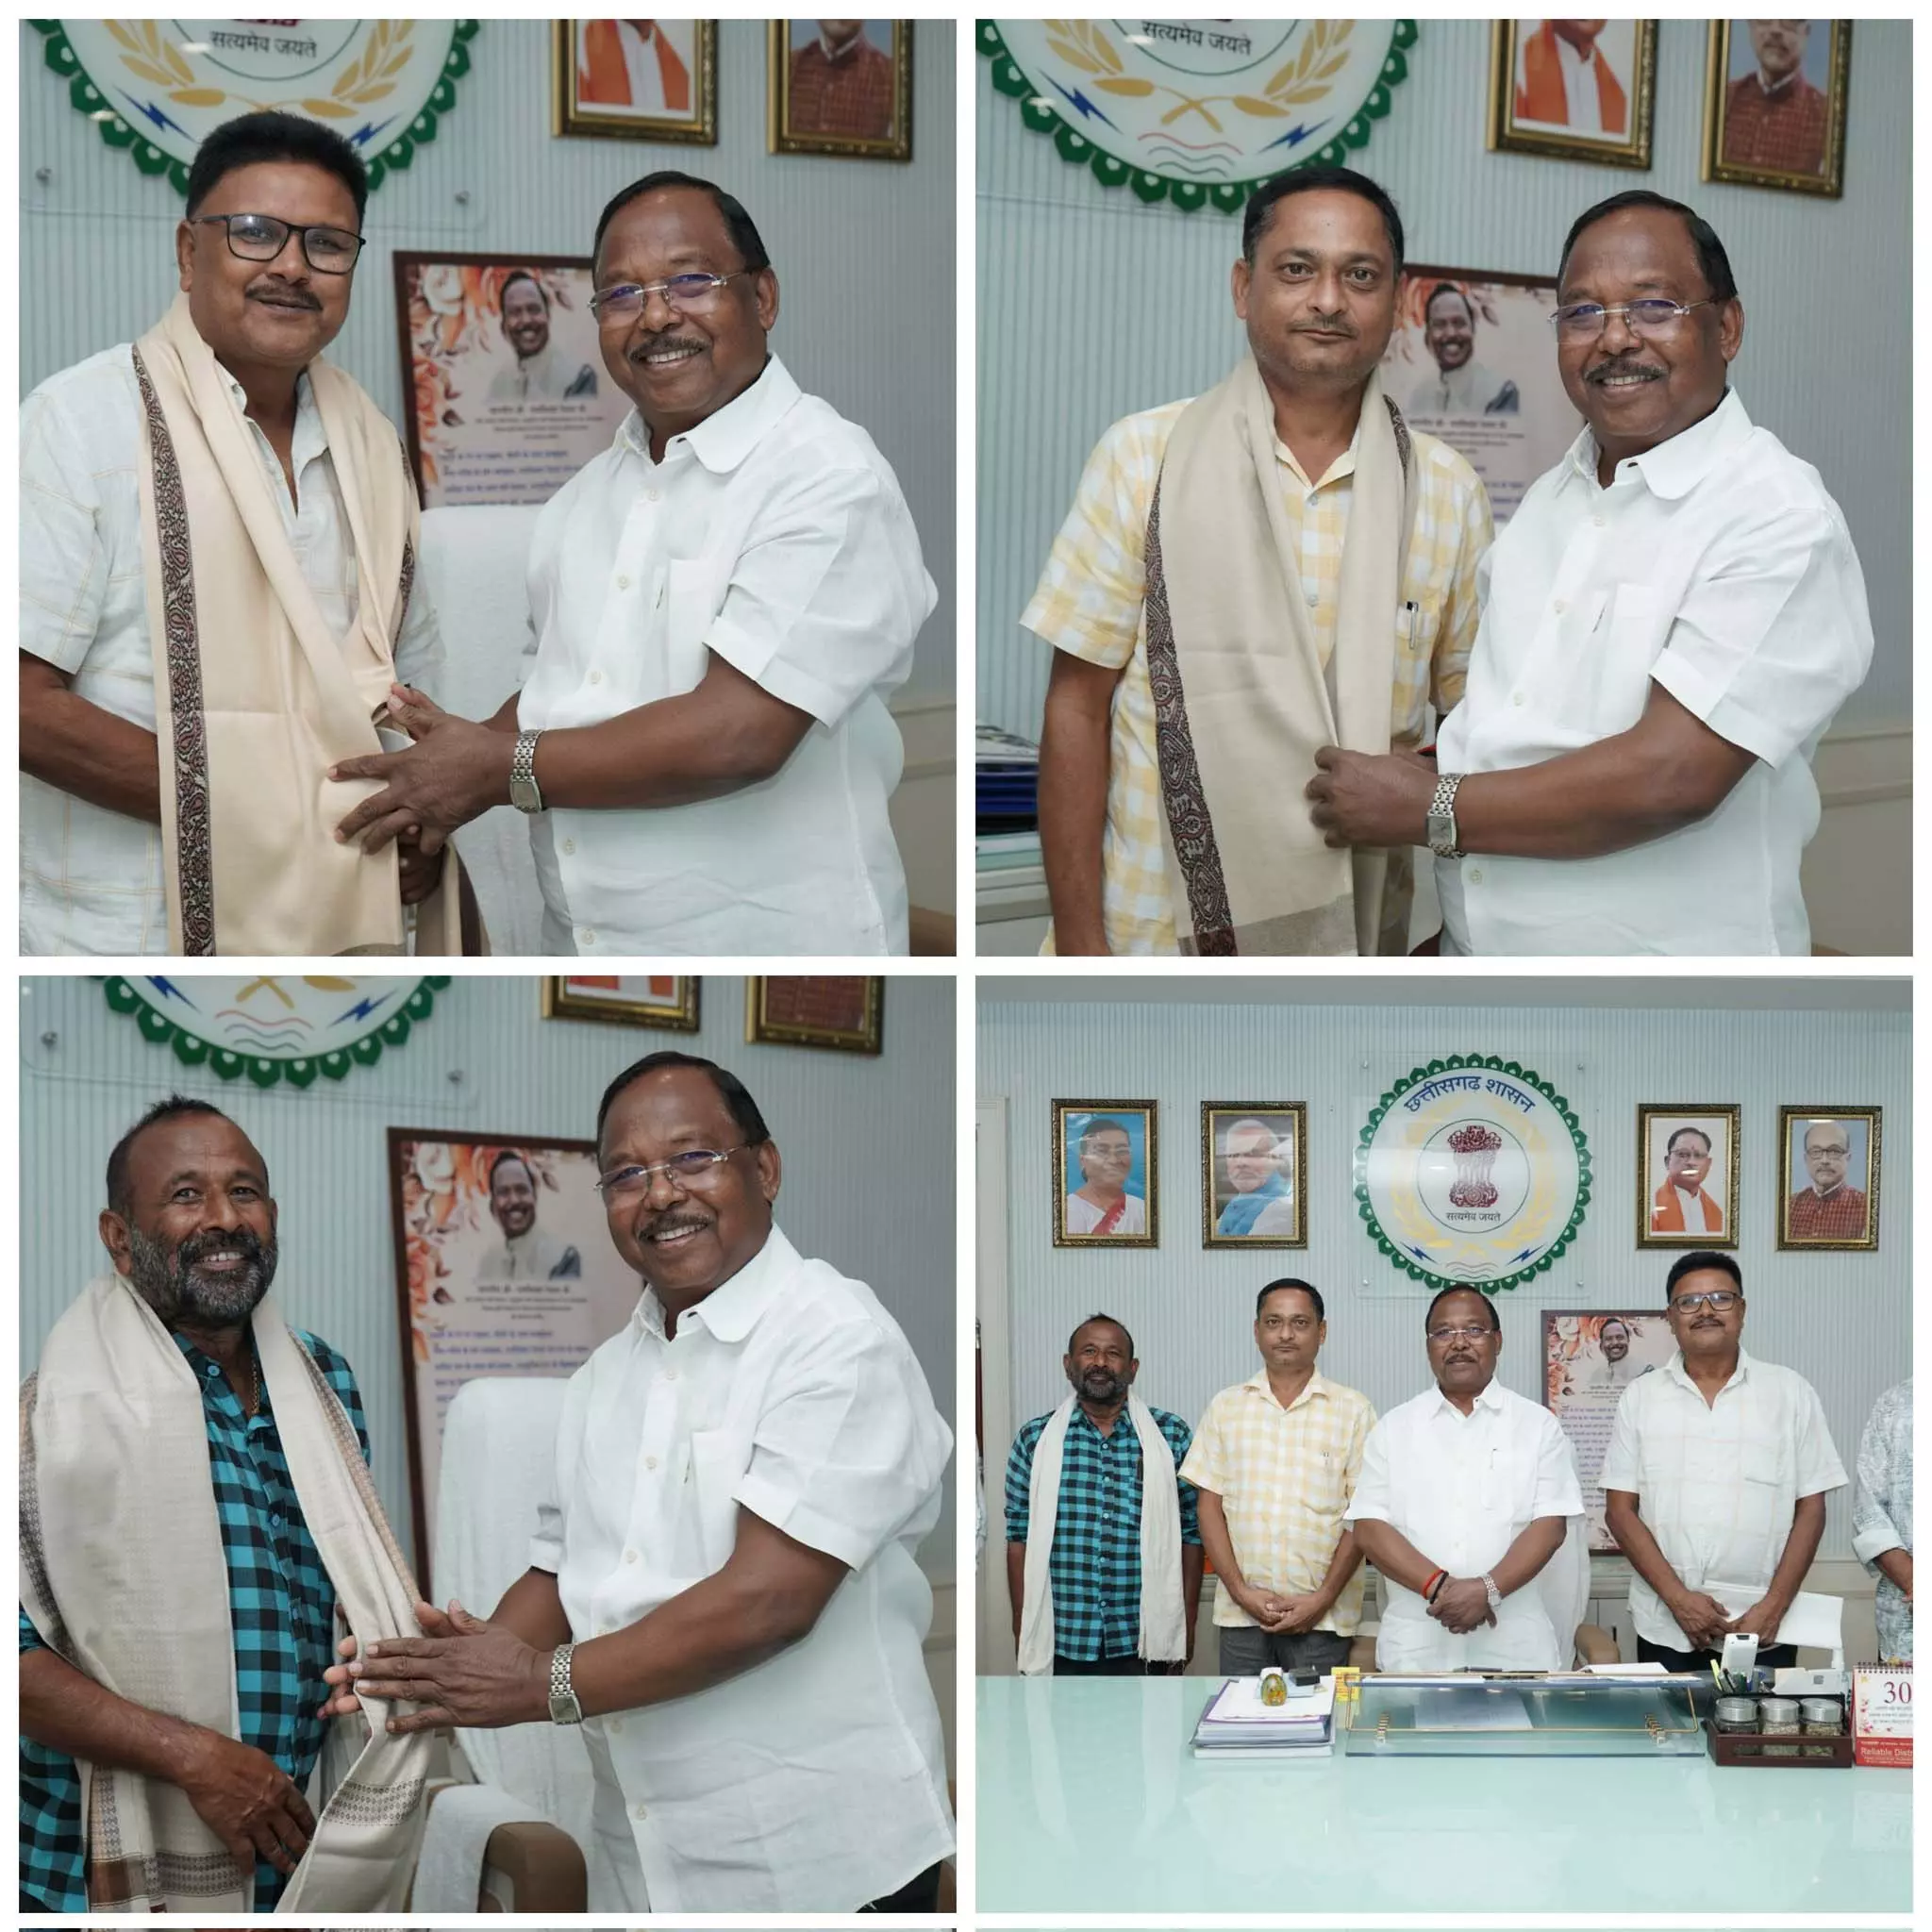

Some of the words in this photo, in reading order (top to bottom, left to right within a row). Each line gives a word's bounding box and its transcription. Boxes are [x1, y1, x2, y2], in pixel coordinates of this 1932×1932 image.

[209, 29, 271, 53] सत्यमेव
[274, 35, 317, 58] जयते
[1141, 20, 1204, 46] सत्यमेव
[1208, 33, 1251, 56] जयते
[1485, 1078, 1536, 1113] शासन
[1445, 1210, 1477, 1221] सत्यमेव
[1478, 1210, 1501, 1221] जयते
[1883, 1681, 1912, 1704] 30
